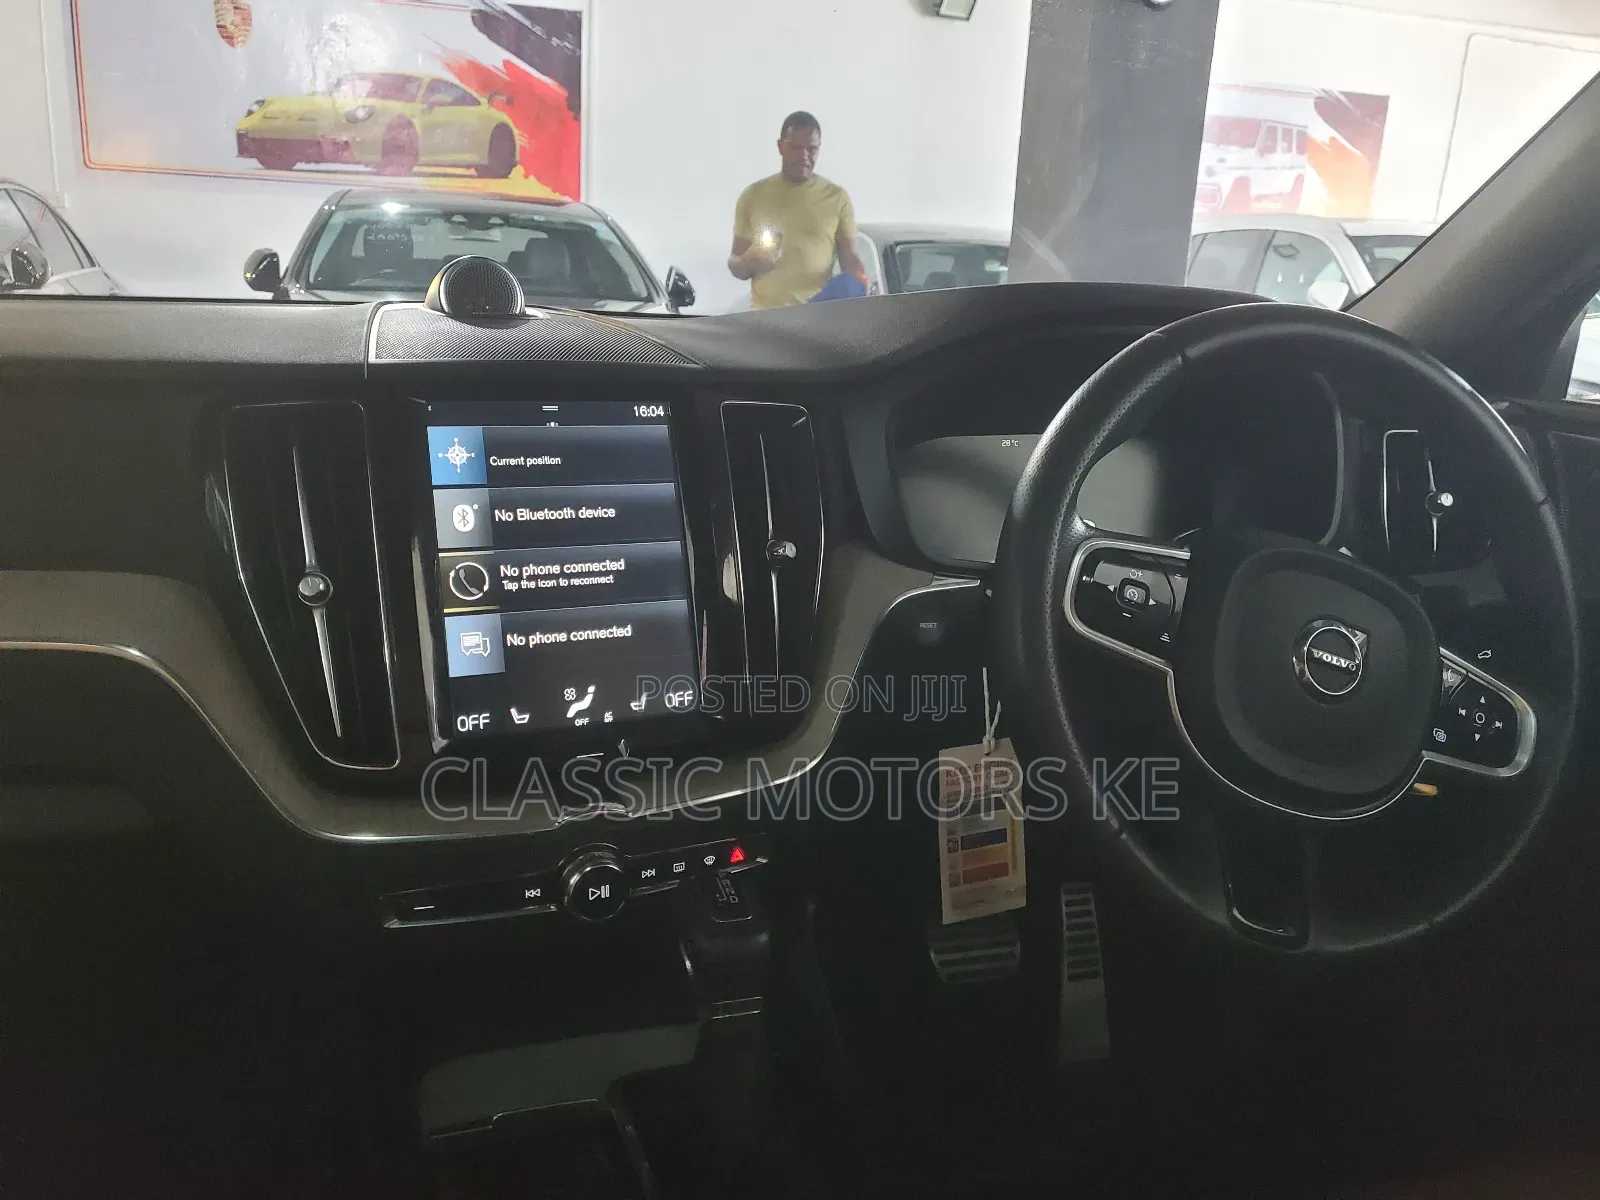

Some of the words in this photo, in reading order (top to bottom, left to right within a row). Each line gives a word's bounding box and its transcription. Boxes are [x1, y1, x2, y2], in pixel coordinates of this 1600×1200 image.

[633, 405, 665, 418] 16:04
[489, 455, 525, 467] Current
[526, 455, 562, 468] position
[494, 508, 515, 522] No
[516, 506, 577, 521] Bluetooth
[577, 505, 616, 518] device
[499, 564, 520, 578] No
[521, 562, 562, 578] phone
[562, 558, 626, 575] connected
[501, 580, 519, 592] Tap
[520, 579, 537, 590] the
[537, 578, 557, 589] icon
[558, 577, 570, 587] to
[569, 574, 615, 586] reconnect
[919, 621, 938, 629] RESET
[506, 633, 527, 648] No
[528, 630, 569, 649] phone
[569, 624, 633, 643] connected
[1311, 649, 1357, 672] VOLVO
[664, 690, 695, 709] OFF
[456, 713, 491, 732] OFF
[574, 717, 590, 727] OFF
